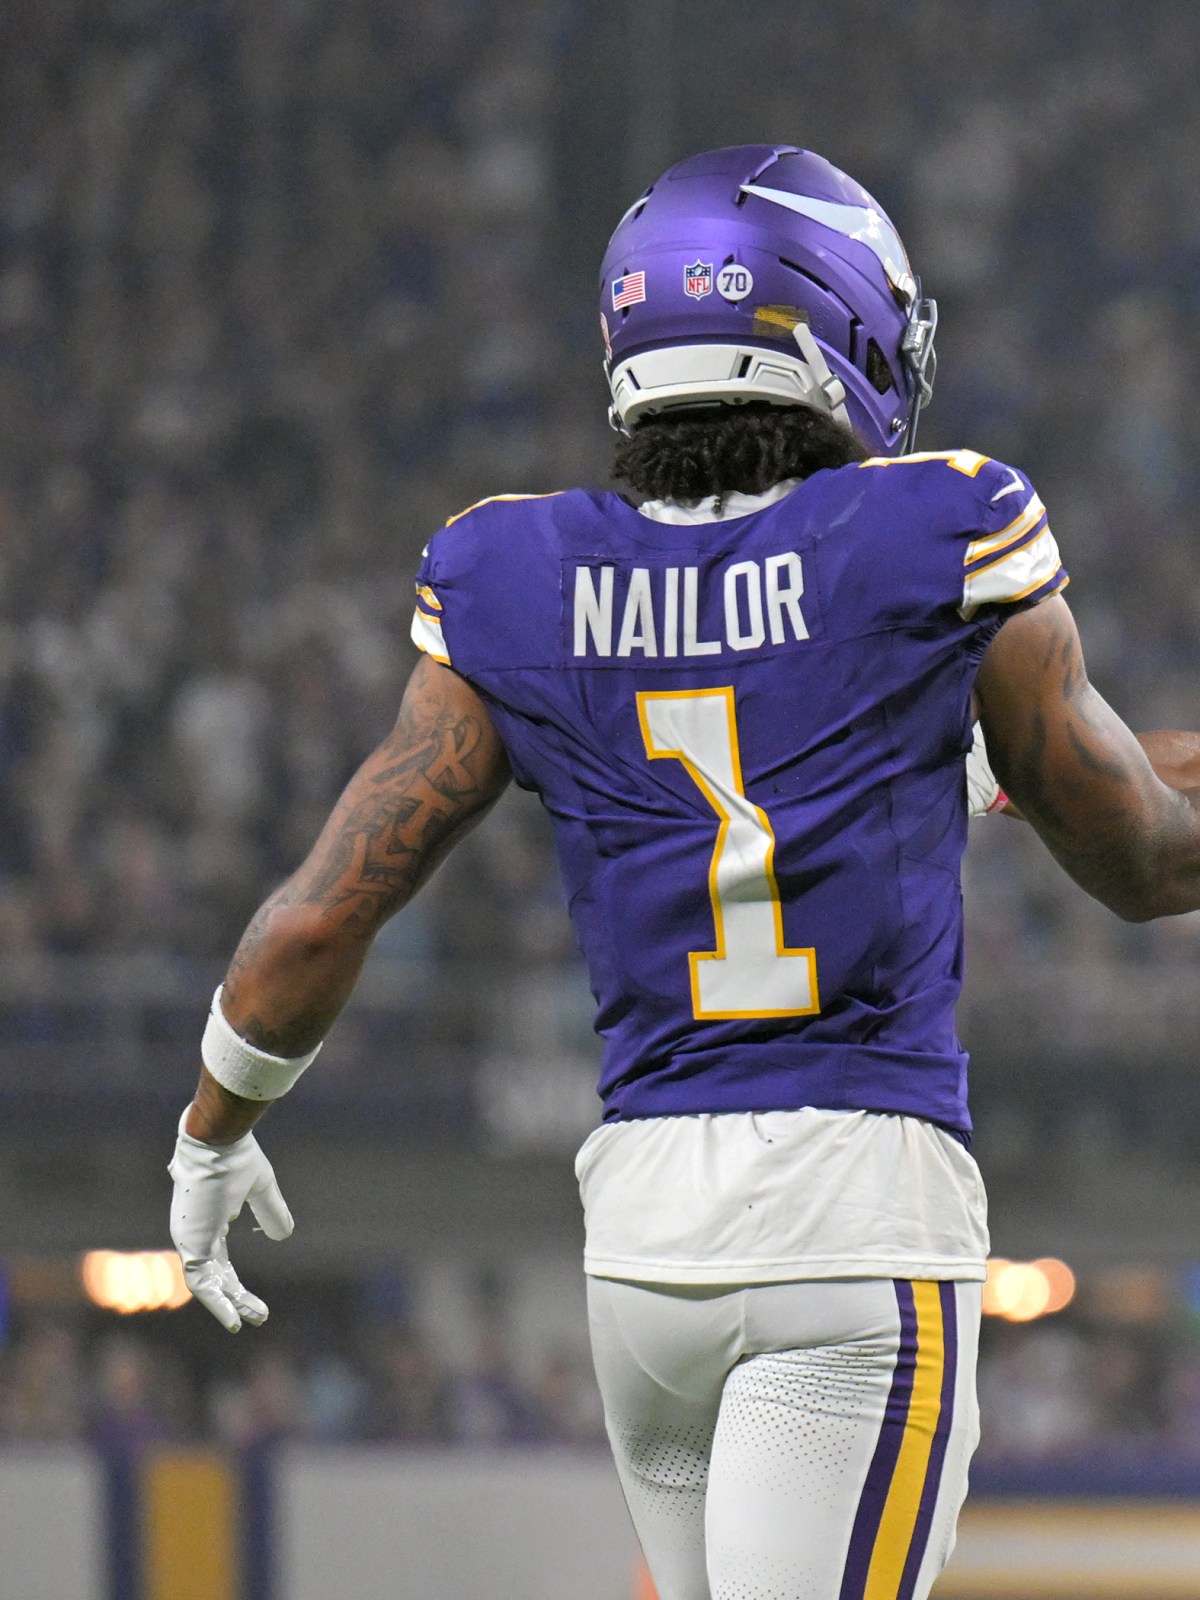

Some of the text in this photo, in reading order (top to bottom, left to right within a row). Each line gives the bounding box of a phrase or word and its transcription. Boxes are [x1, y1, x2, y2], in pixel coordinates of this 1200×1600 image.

[688, 278, 709, 293] NFL
[723, 273, 747, 292] 70
[574, 551, 810, 657] NAILOR
[636, 685, 821, 1020] 1
